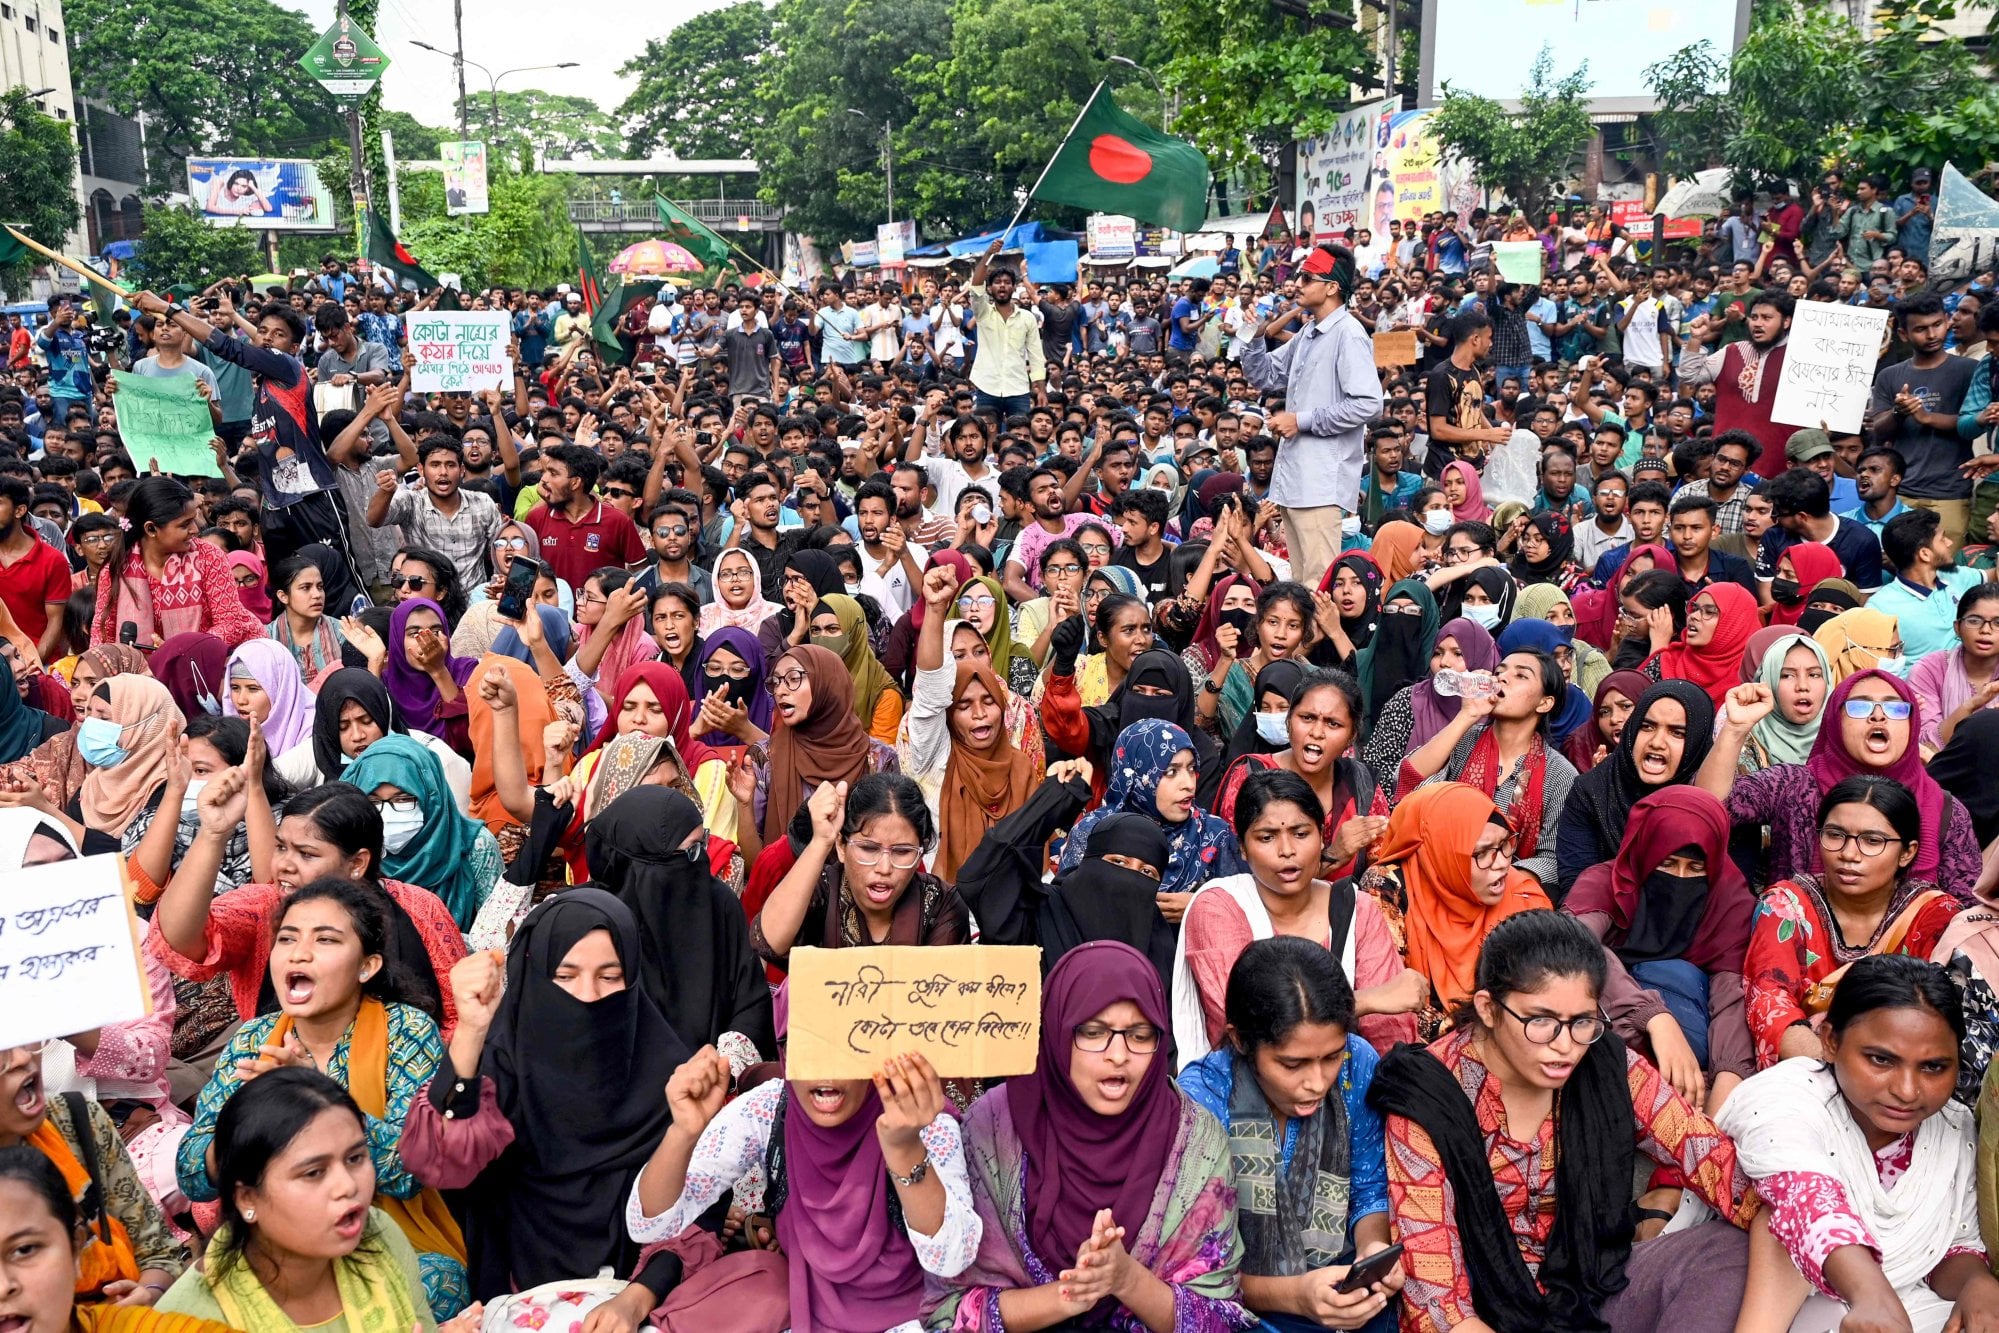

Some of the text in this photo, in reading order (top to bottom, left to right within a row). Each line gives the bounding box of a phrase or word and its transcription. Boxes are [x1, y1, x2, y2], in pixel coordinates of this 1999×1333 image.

[1322, 208, 1358, 228] শুভেচ্ছা
[413, 320, 500, 342] কোটা নামের
[418, 341, 492, 364] কুঠার দিয়ে
[1812, 337, 1871, 357] বাংলায়
[416, 360, 502, 374] মেধার পিঠে আঘাত
[440, 374, 465, 388] কেন
[1803, 386, 1845, 412] নাই
[16, 893, 122, 936] অগ্রসর
[824, 964, 906, 1007] নারী
[908, 973, 958, 1008] তুমি
[958, 981, 982, 997] কম
[848, 1011, 1032, 1054] কোটা তবে কোন বিবেকে!!
